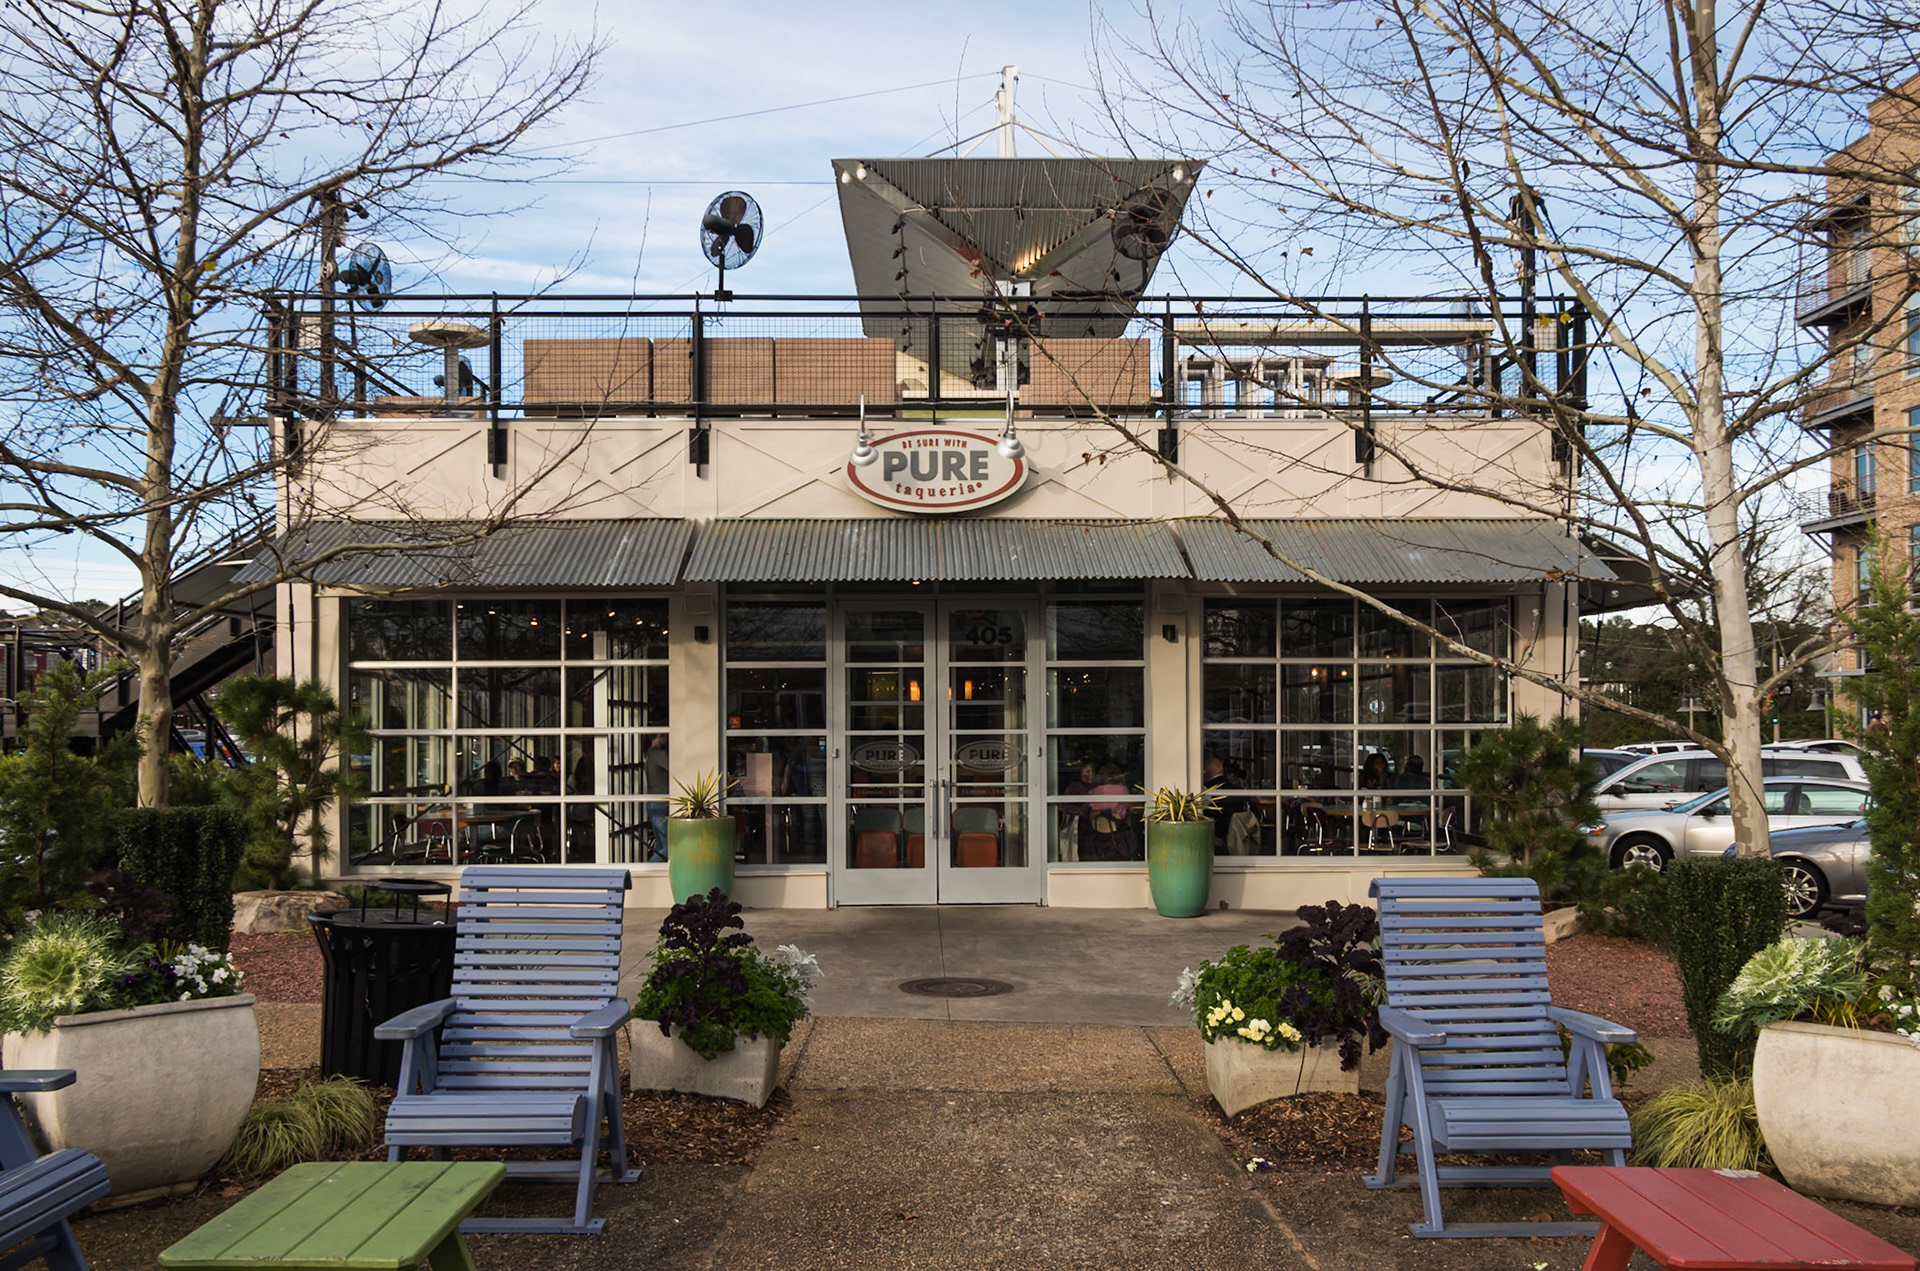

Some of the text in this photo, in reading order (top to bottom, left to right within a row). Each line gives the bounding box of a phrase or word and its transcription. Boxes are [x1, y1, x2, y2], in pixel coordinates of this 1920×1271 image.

[917, 438, 939, 448] SURE
[944, 439, 967, 448] WITH
[883, 451, 989, 481] PURE
[896, 483, 975, 499] taqueria
[966, 627, 1012, 644] 405
[865, 749, 906, 762] PURE
[969, 749, 1009, 761] PURE
